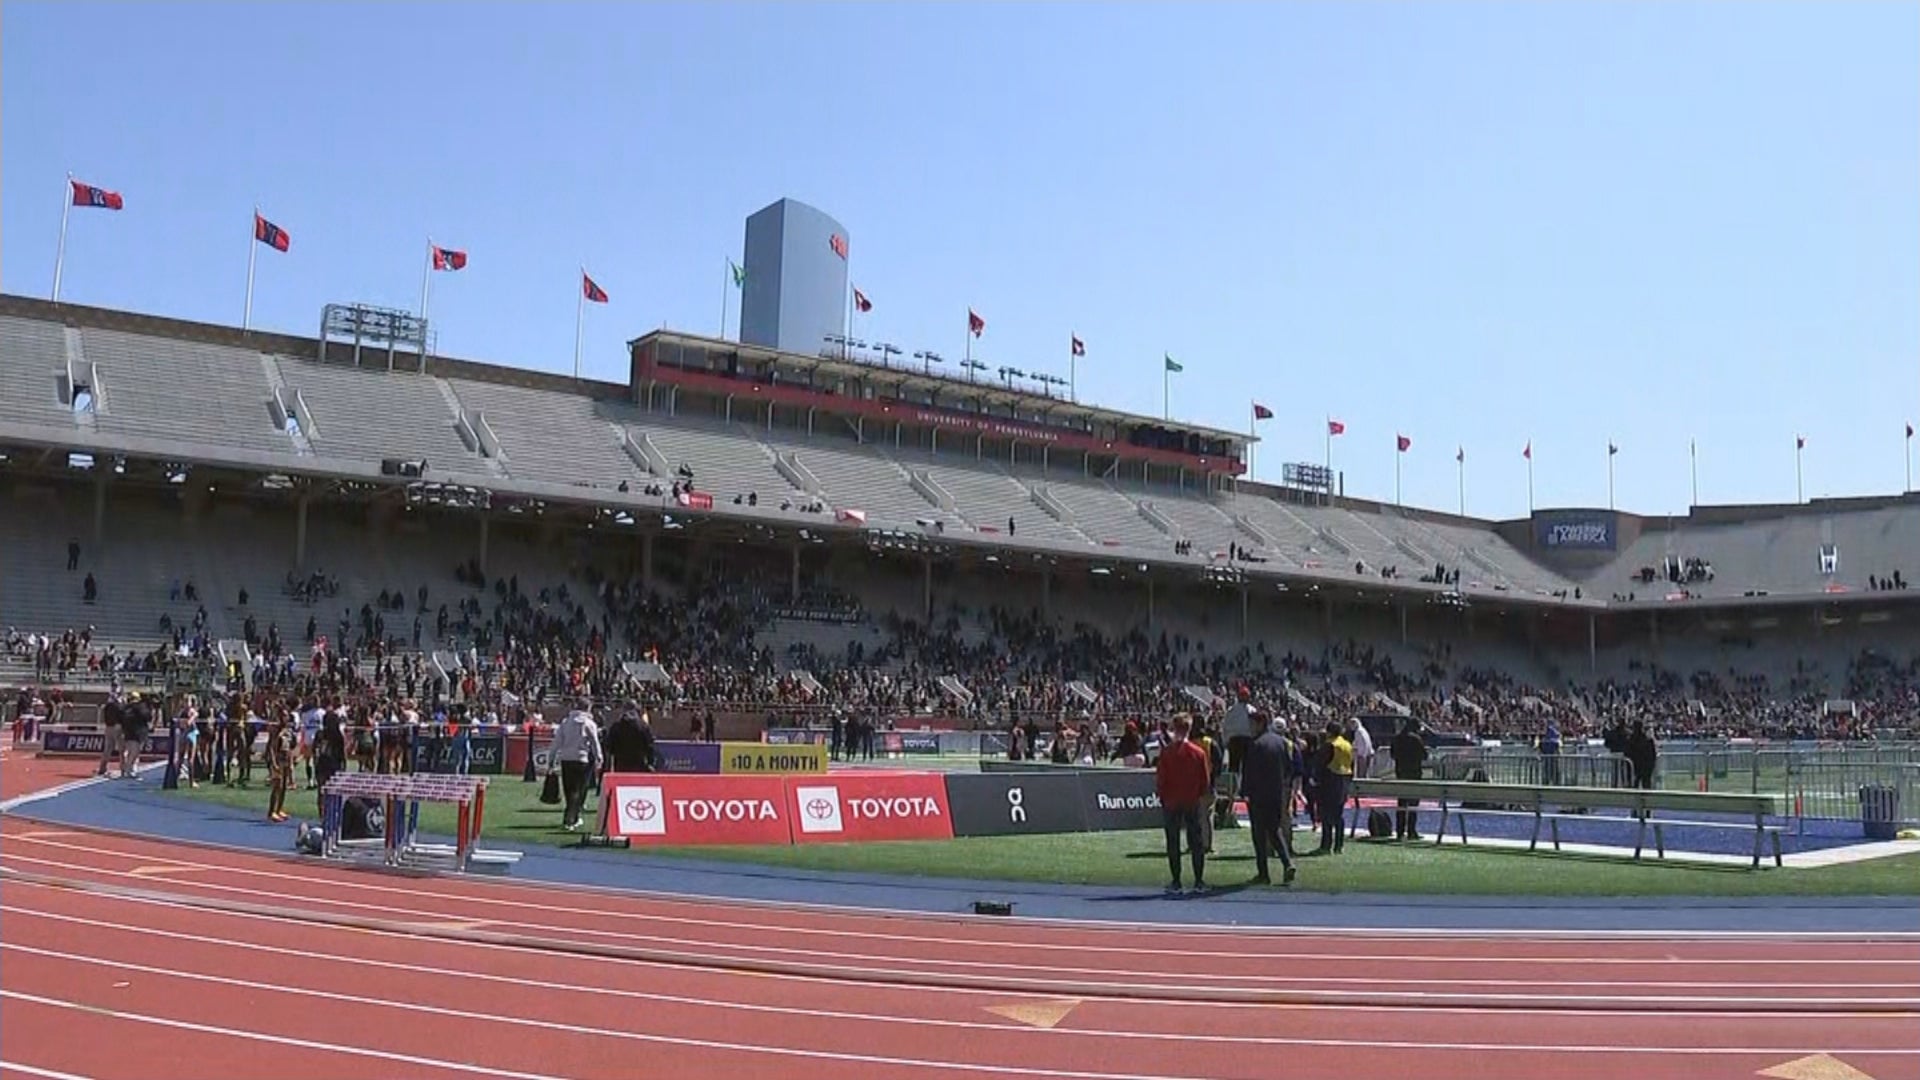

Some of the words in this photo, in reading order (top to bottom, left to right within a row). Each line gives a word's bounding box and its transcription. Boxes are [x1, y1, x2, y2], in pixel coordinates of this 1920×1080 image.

[917, 412, 971, 427] UNIVERSITY
[977, 421, 989, 430] OF
[995, 424, 1058, 441] PENNSYLVANIA
[66, 736, 103, 749] PENN
[755, 755, 765, 771] A
[769, 755, 819, 771] MONTH
[673, 799, 778, 821] TOYOTA
[847, 797, 941, 819] TOYOTA
[1098, 793, 1125, 809] Run
[1127, 796, 1144, 809] on
